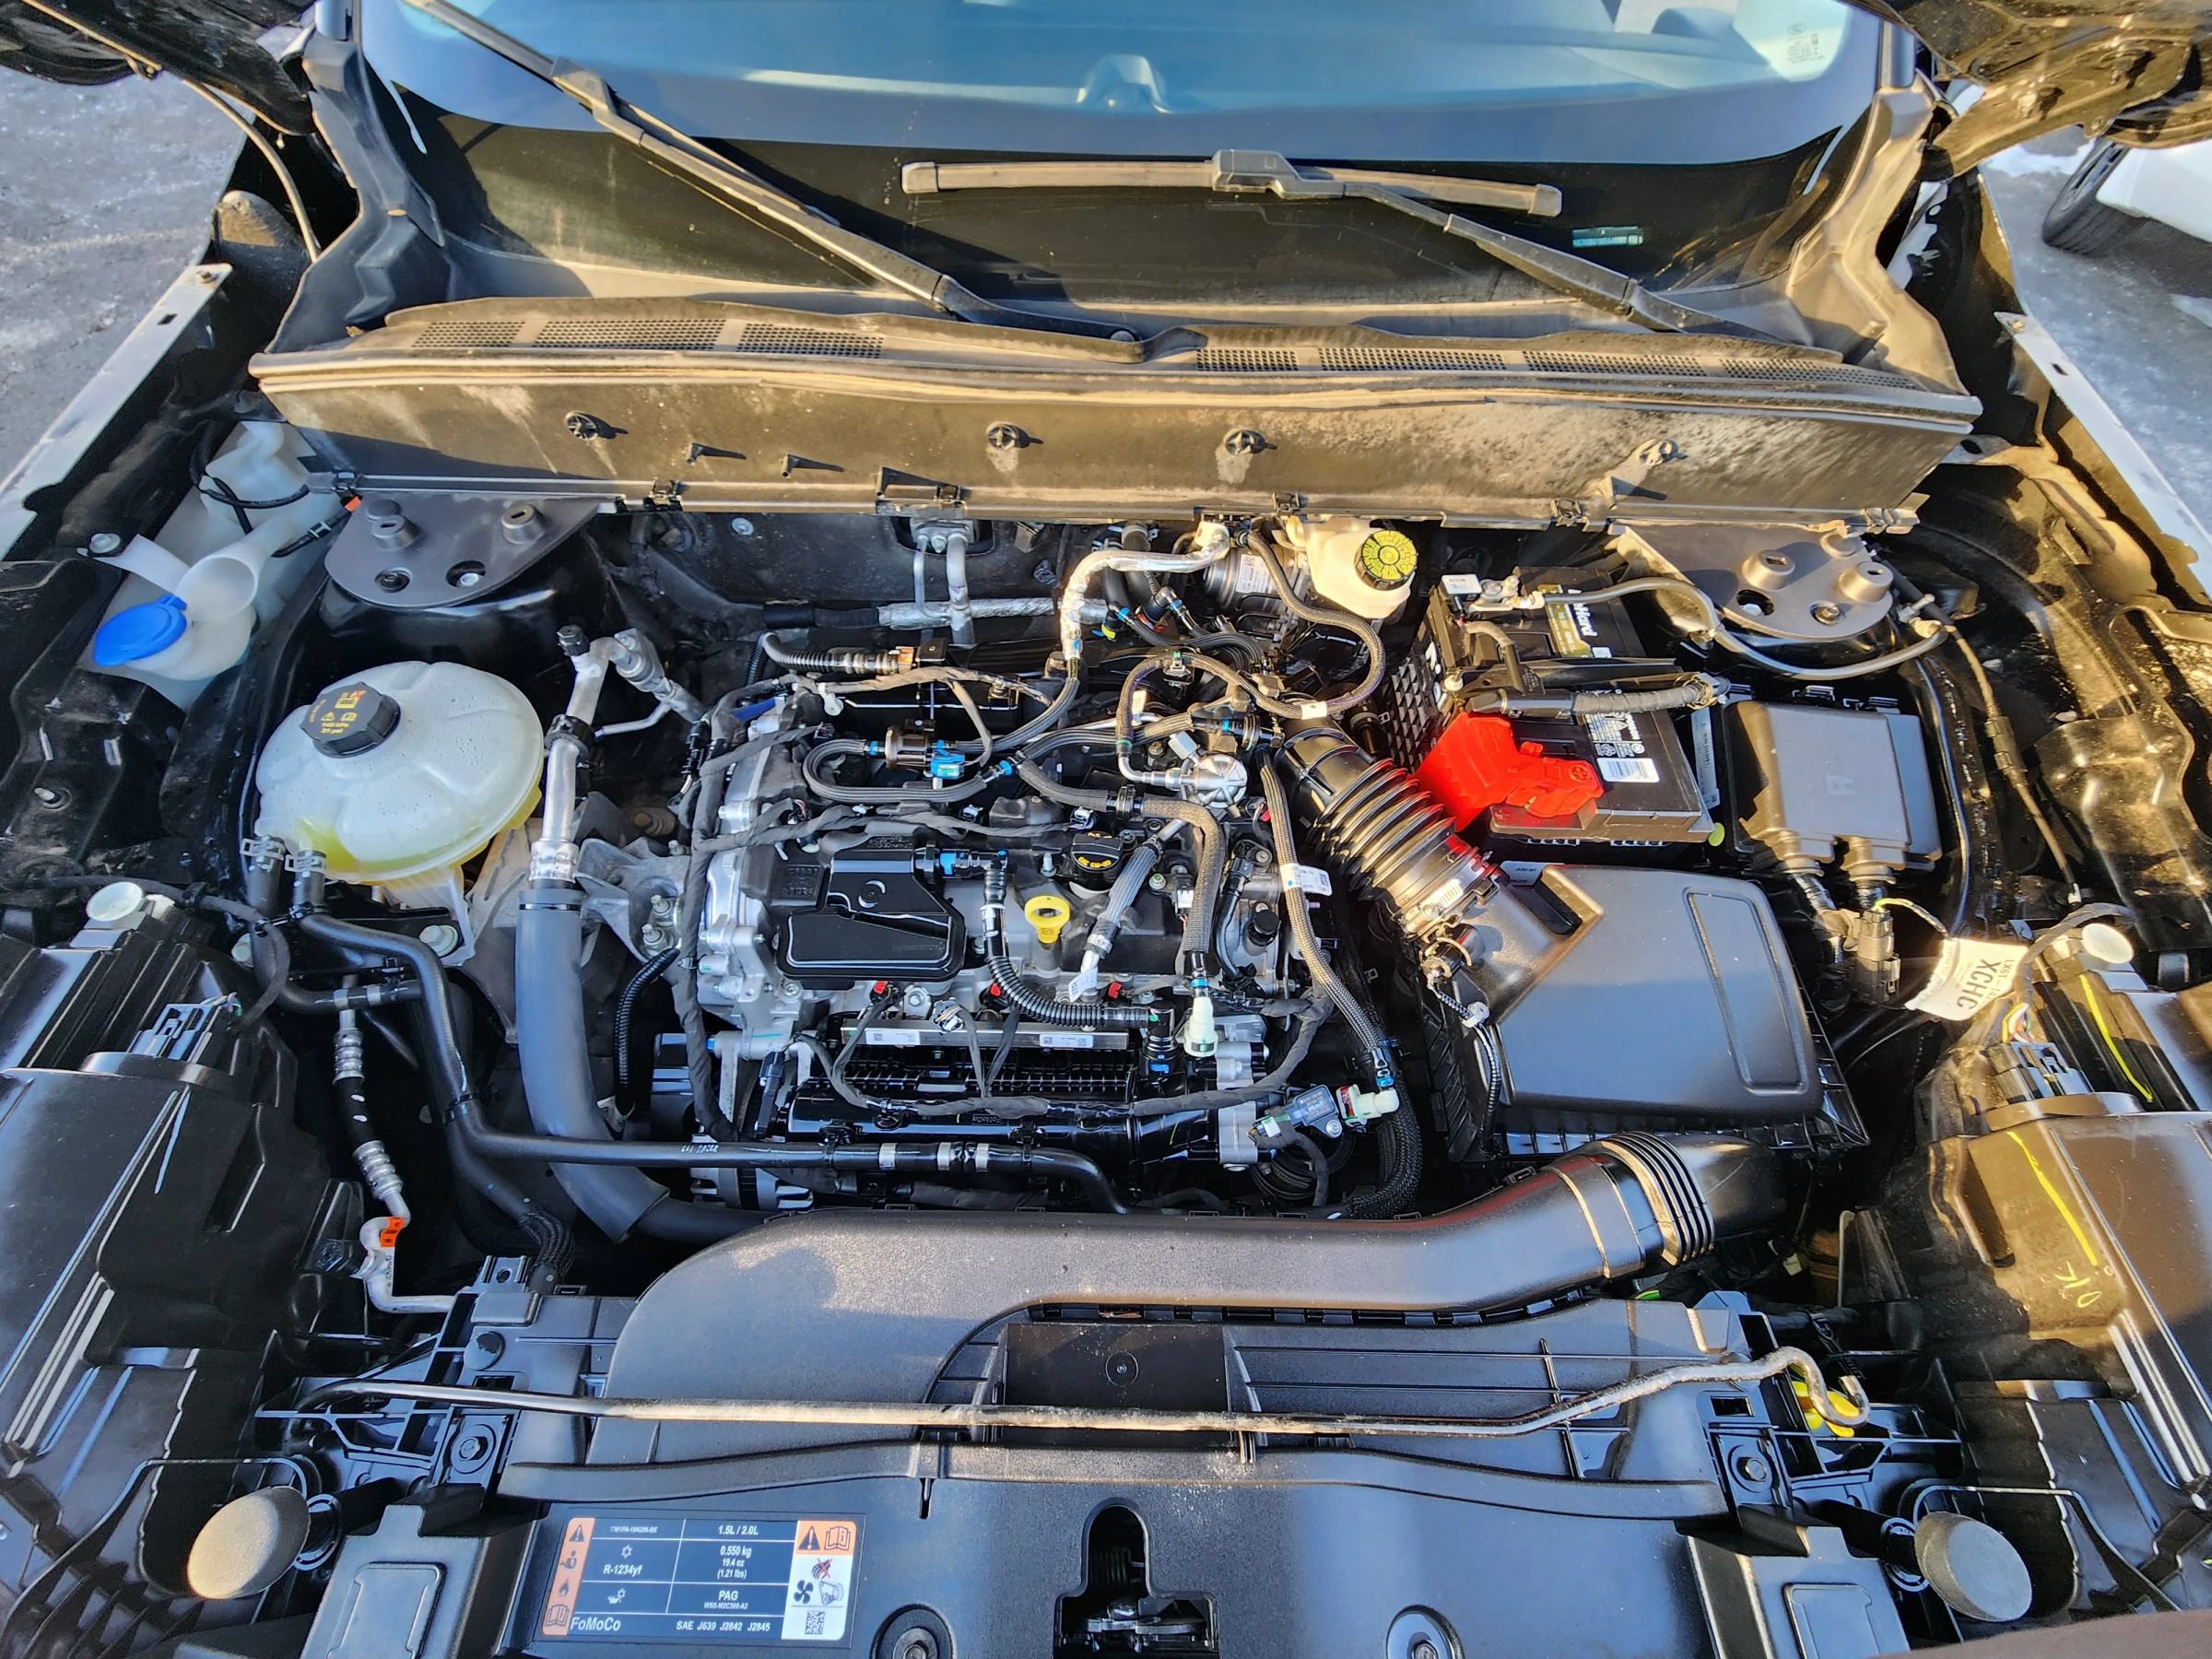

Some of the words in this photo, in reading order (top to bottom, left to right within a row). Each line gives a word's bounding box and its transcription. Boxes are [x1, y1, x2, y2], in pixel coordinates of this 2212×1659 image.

[1956, 959, 2002, 1010] XCHC
[718, 1525, 735, 1535] 1.5L
[741, 1526, 759, 1535] 2.0L
[720, 1546, 740, 1556] 0.550
[741, 1546, 752, 1559] kg
[722, 1559, 735, 1567] 19.4
[603, 1564, 643, 1578] R-1234yf
[717, 1570, 734, 1580] (1.21
[734, 1570, 747, 1580] lbs)
[718, 1590, 739, 1601] PAG
[570, 1617, 621, 1631] FoMoCo
[677, 1620, 694, 1630] SAE
[697, 1621, 717, 1631] J639
[720, 1622, 743, 1631] J2842
[747, 1622, 771, 1632] J2845
